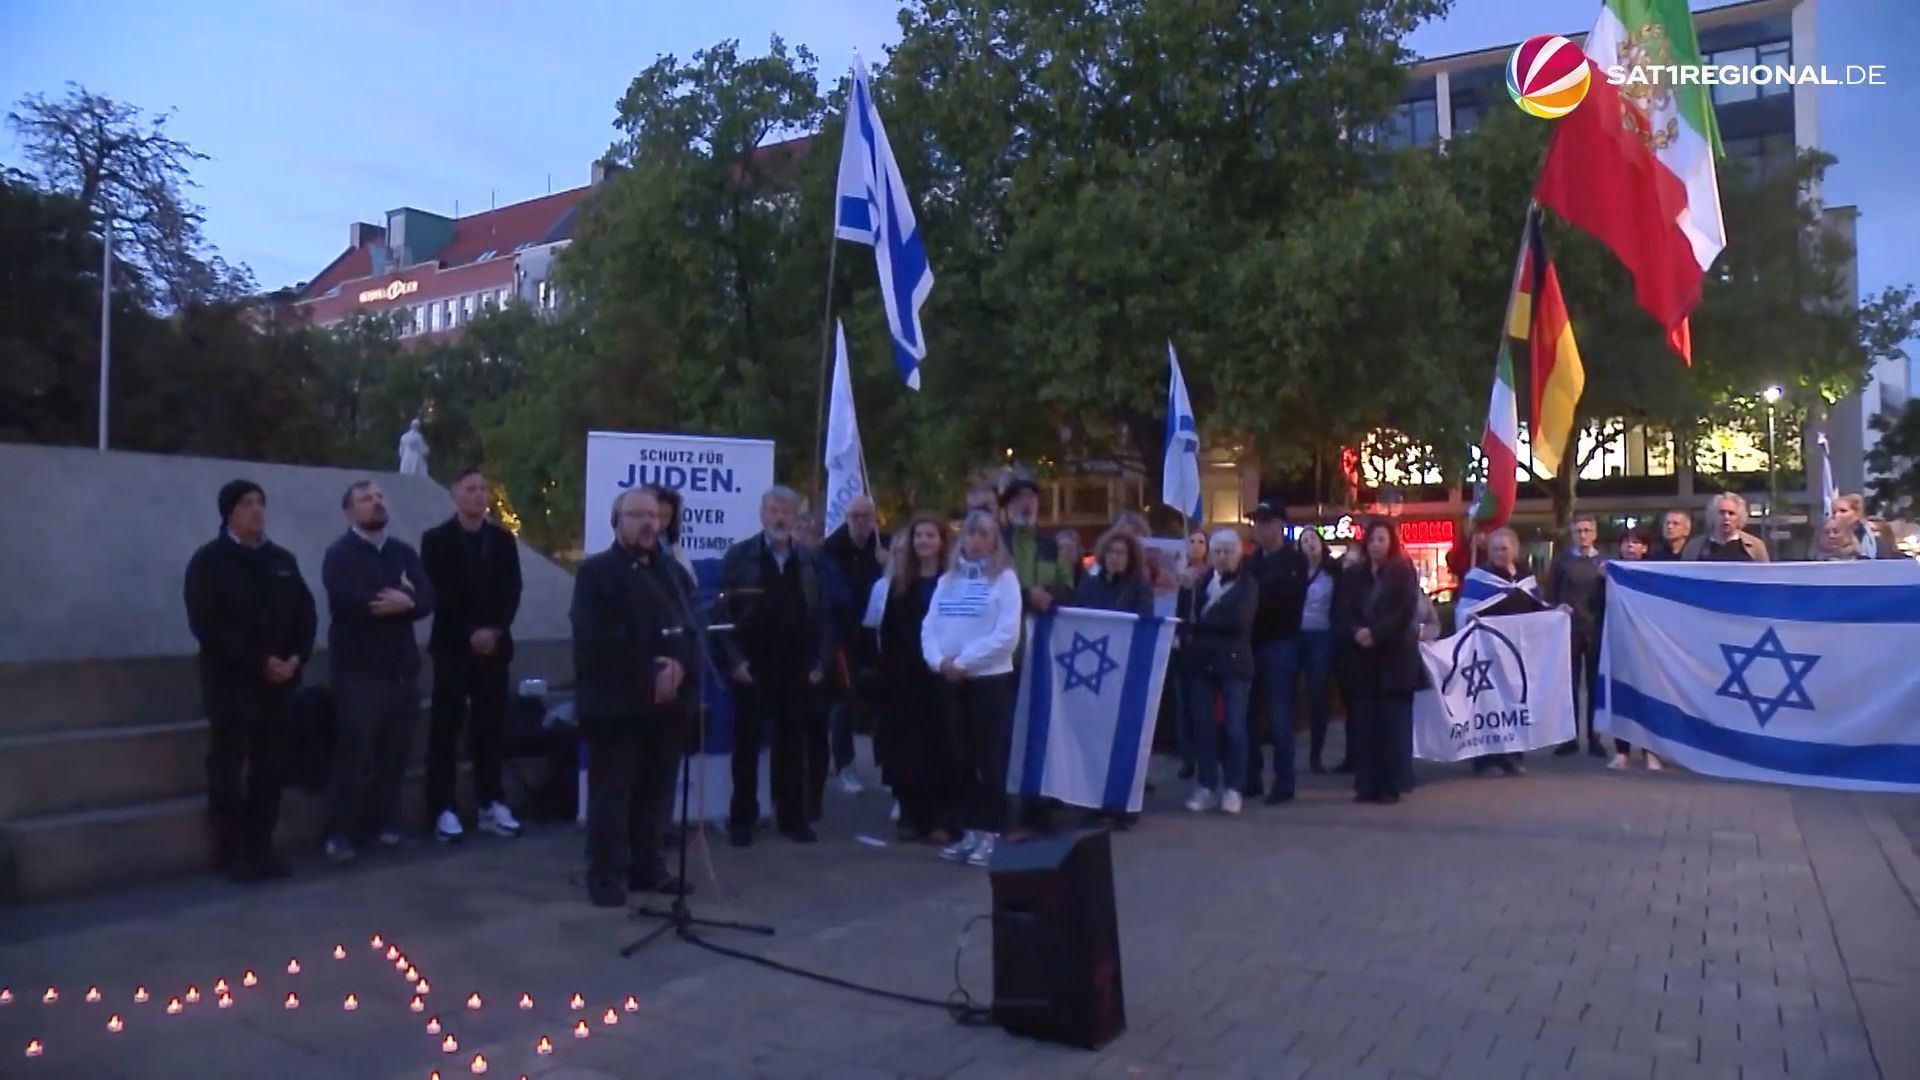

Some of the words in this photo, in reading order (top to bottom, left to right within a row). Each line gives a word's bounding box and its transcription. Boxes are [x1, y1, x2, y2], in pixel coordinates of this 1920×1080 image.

[640, 449, 694, 464] SCHUTZ
[699, 451, 724, 465] FÜR
[617, 464, 742, 493] JUDEN.
[682, 508, 725, 524] OVER
[1474, 709, 1530, 730] DOME
